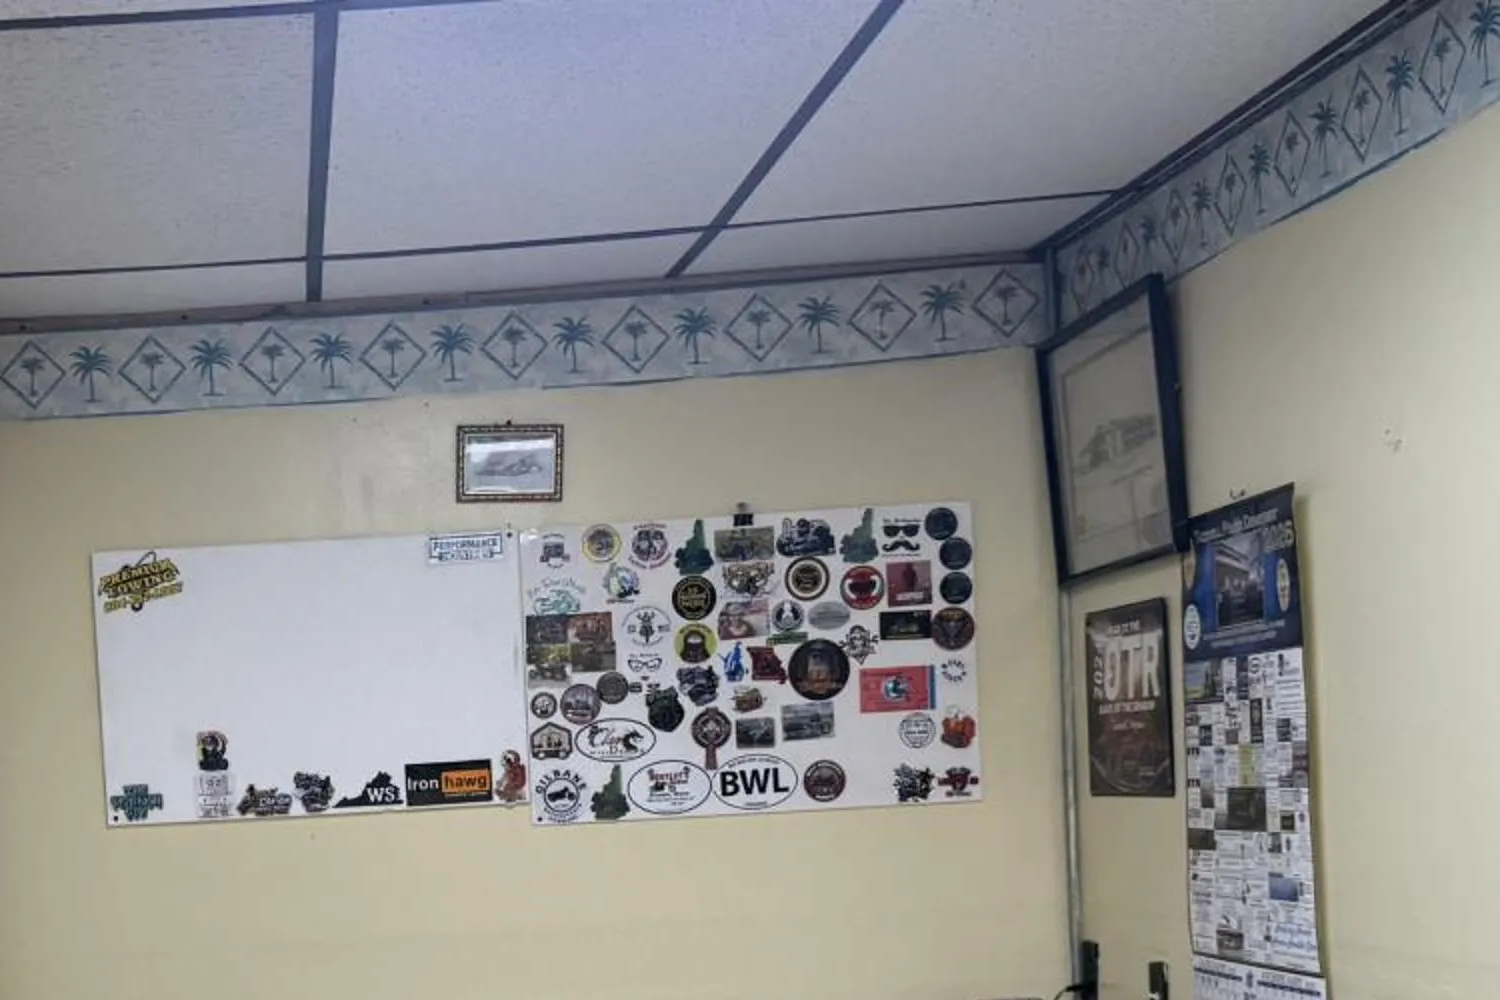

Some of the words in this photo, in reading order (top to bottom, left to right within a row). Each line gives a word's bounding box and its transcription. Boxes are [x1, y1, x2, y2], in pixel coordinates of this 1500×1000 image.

[443, 774, 488, 789] hawg
[720, 767, 789, 797] BWL
[367, 786, 396, 803] WS
